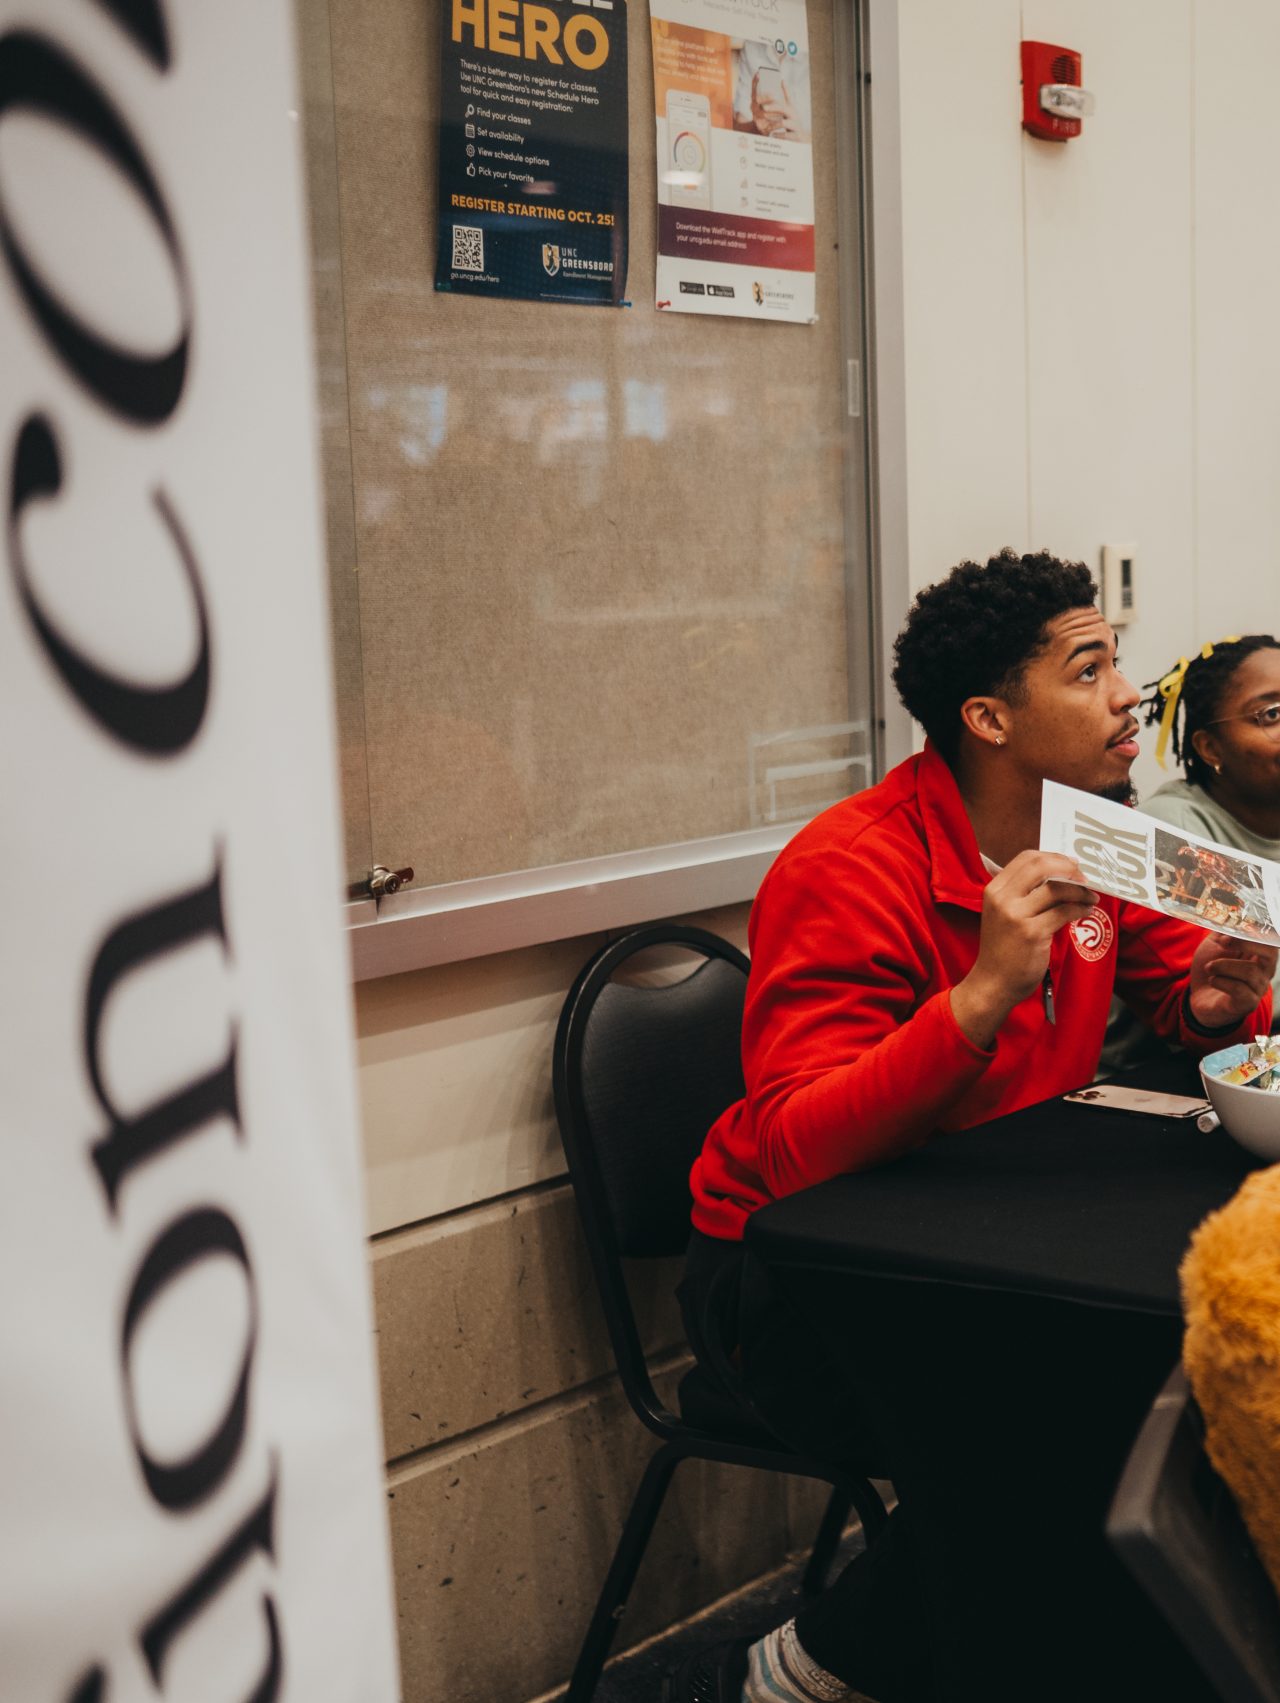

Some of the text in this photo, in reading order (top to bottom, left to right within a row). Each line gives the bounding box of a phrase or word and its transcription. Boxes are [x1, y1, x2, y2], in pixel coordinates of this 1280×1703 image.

[451, 0, 610, 71] HERO
[460, 58, 481, 73] There's
[487, 66, 507, 78] better
[508, 71, 523, 82] way
[523, 73, 531, 83] to
[531, 75, 558, 89] register
[559, 79, 570, 89] for
[570, 82, 599, 94] classes.
[460, 71, 600, 106] Use UNC Greensboro's new Schedule Hero
[460, 84, 574, 113] tool for quick and easy registration:
[476, 107, 532, 126] Find your classes
[477, 127, 525, 145] Set availability
[477, 146, 550, 167] View schedule options
[478, 166, 535, 184] Pick your favorite
[451, 193, 616, 227] REGISTER STARTING OCT. 25!
[675, 222, 701, 234] Download
[561, 247, 578, 258] UNC
[562, 259, 614, 272] GREENSBORO
